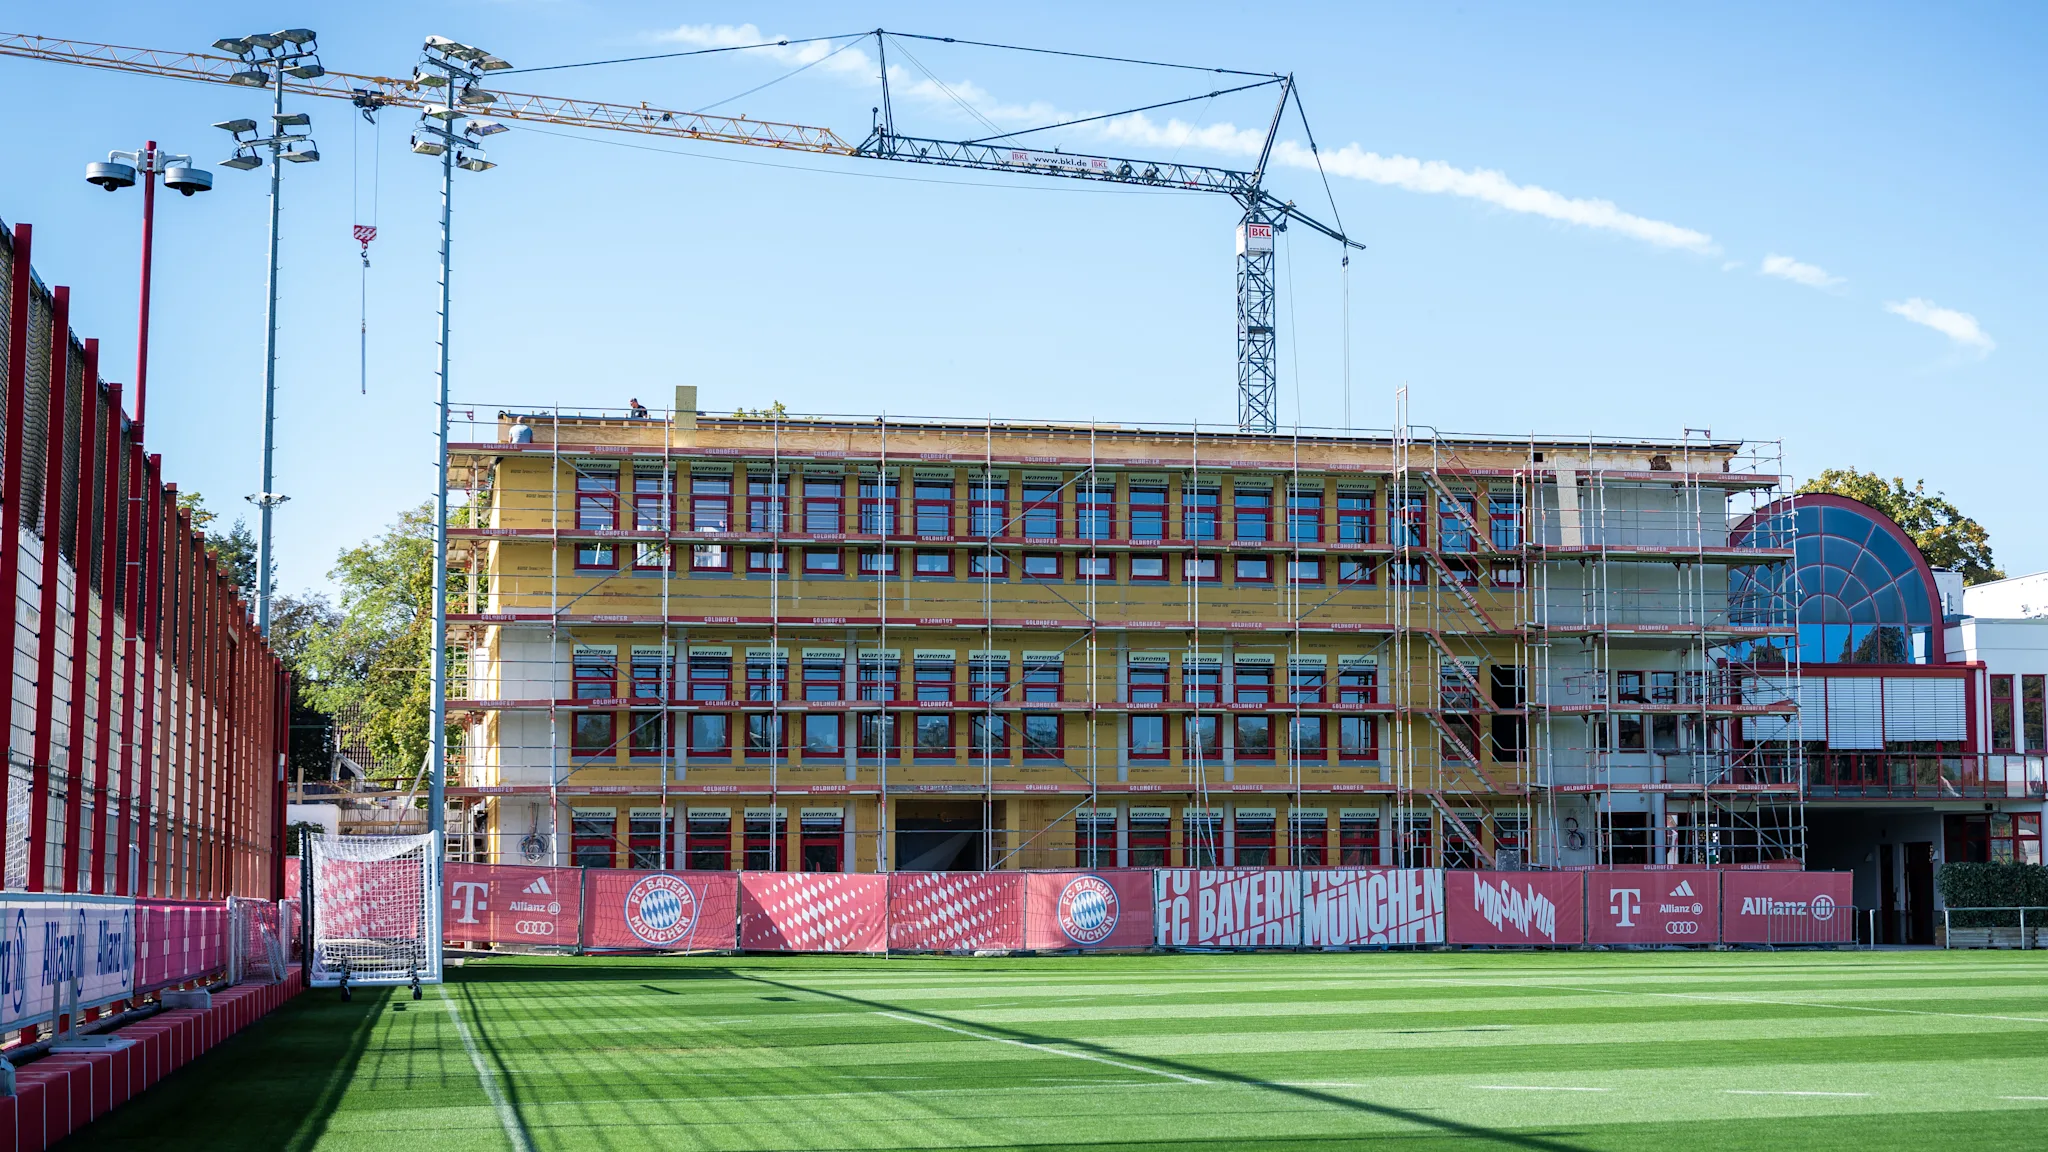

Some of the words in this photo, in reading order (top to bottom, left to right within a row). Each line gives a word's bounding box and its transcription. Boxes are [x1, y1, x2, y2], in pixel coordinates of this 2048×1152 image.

[1033, 155, 1088, 168] www.bkl.de
[1252, 228, 1272, 237] BKL
[631, 888, 646, 905] FC
[645, 878, 691, 906] BAYERN
[1061, 888, 1076, 905] FC
[1075, 879, 1115, 905] BAYERN
[509, 901, 546, 912] Allianz
[1159, 895, 1190, 945] FC
[1199, 870, 1300, 937] BAYERN
[1304, 870, 1443, 945] MÜNCHEN
[1473, 872, 1502, 933] MIA
[1500, 879, 1529, 938] SAN
[1527, 883, 1556, 942] MIA
[1659, 903, 1691, 913] Allianz
[1741, 896, 1807, 916] Allianz
[630, 914, 692, 942] MÜNCHEN
[1062, 915, 1114, 940] MÜNCHEN
[42, 921, 75, 987] Allianz
[96, 919, 121, 976] Allianz
